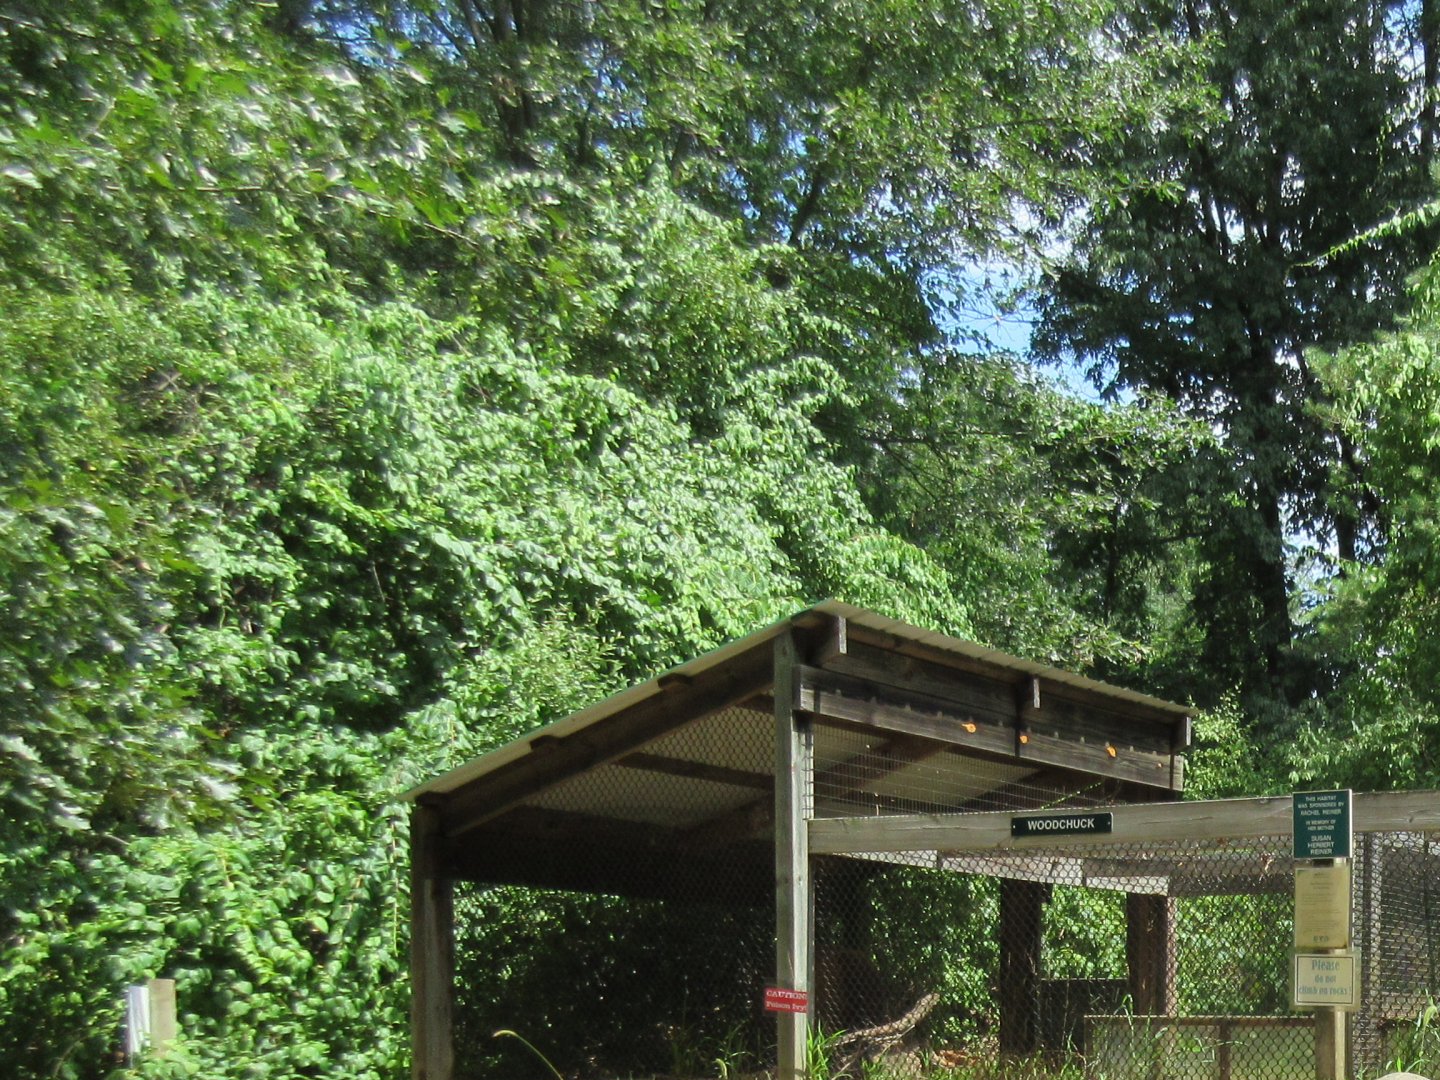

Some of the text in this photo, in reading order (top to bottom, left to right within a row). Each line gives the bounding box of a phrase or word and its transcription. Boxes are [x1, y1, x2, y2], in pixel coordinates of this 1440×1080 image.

[1027, 818, 1095, 831] WOODCHUCK
[1311, 958, 1340, 971] Please
[1314, 973, 1337, 983] do not
[1298, 985, 1318, 994] climb
[1319, 987, 1328, 995] on
[766, 1001, 791, 1009] Poison
